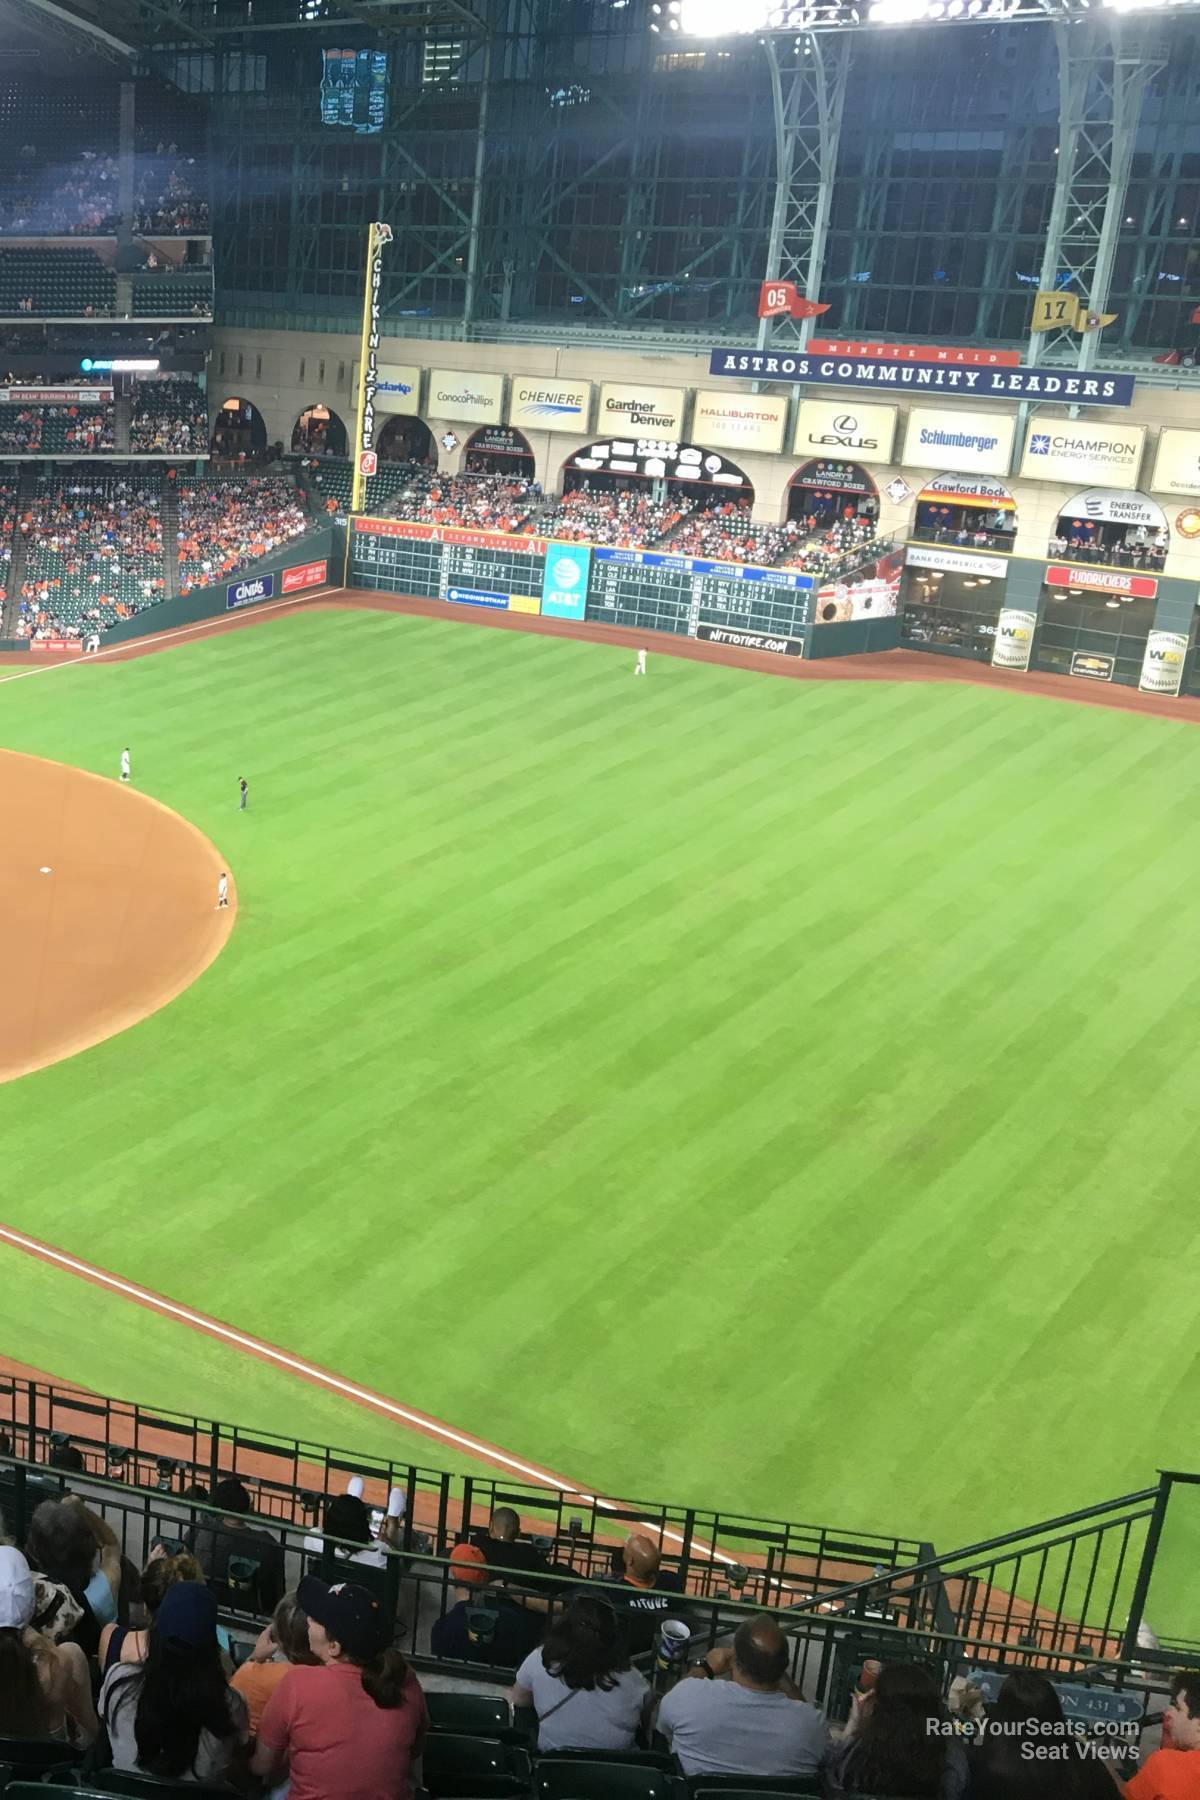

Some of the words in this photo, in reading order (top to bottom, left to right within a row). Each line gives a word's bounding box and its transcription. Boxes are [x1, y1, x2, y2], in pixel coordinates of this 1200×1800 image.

[368, 259, 382, 348] CHIKIN
[767, 288, 786, 307] 05
[1044, 300, 1066, 320] 17
[828, 344, 916, 357] MINUTE
[938, 352, 997, 363] MAID
[366, 352, 377, 382] IZ
[723, 355, 810, 375] ASTROS
[820, 362, 980, 387] COMMUNITY
[991, 373, 1115, 397] LEADERS
[437, 391, 494, 408] ConocoPhillips
[519, 390, 583, 406] CHENIERE
[606, 398, 655, 413] Gardner
[362, 386, 376, 449] FARE
[630, 413, 675, 428] Denver
[700, 408, 778, 422] HALLIBURTON
[809, 433, 878, 449] LEXUS
[920, 428, 998, 452] Schlumberger
[1053, 436, 1136, 455] CHAMPION
[1051, 450, 1087, 460] ENERGY
[1088, 454, 1134, 465] SERVICES
[816, 470, 853, 480] LANDRY'S
[802, 478, 841, 488] CRAWFORD
[843, 481, 865, 491] BOXES
[932, 482, 978, 494] Crawford
[980, 486, 1005, 497] Bock
[1110, 501, 1143, 511] ENERGY
[1109, 509, 1151, 521] TRANSFER
[910, 554, 932, 563] BANK
[946, 559, 983, 569] AMERICA
[1069, 570, 1132, 590] FUDDRUCKERS
[236, 580, 264, 600] CINTAS
[548, 592, 581, 606] AT&T
[709, 630, 788, 653] NITTOTIRE.COM
[1001, 627, 1029, 641] WM
[1149, 650, 1181, 665] WM
[1073, 667, 1109, 677] CHEVROLET
[1085, 1700, 1109, 1712] 431
